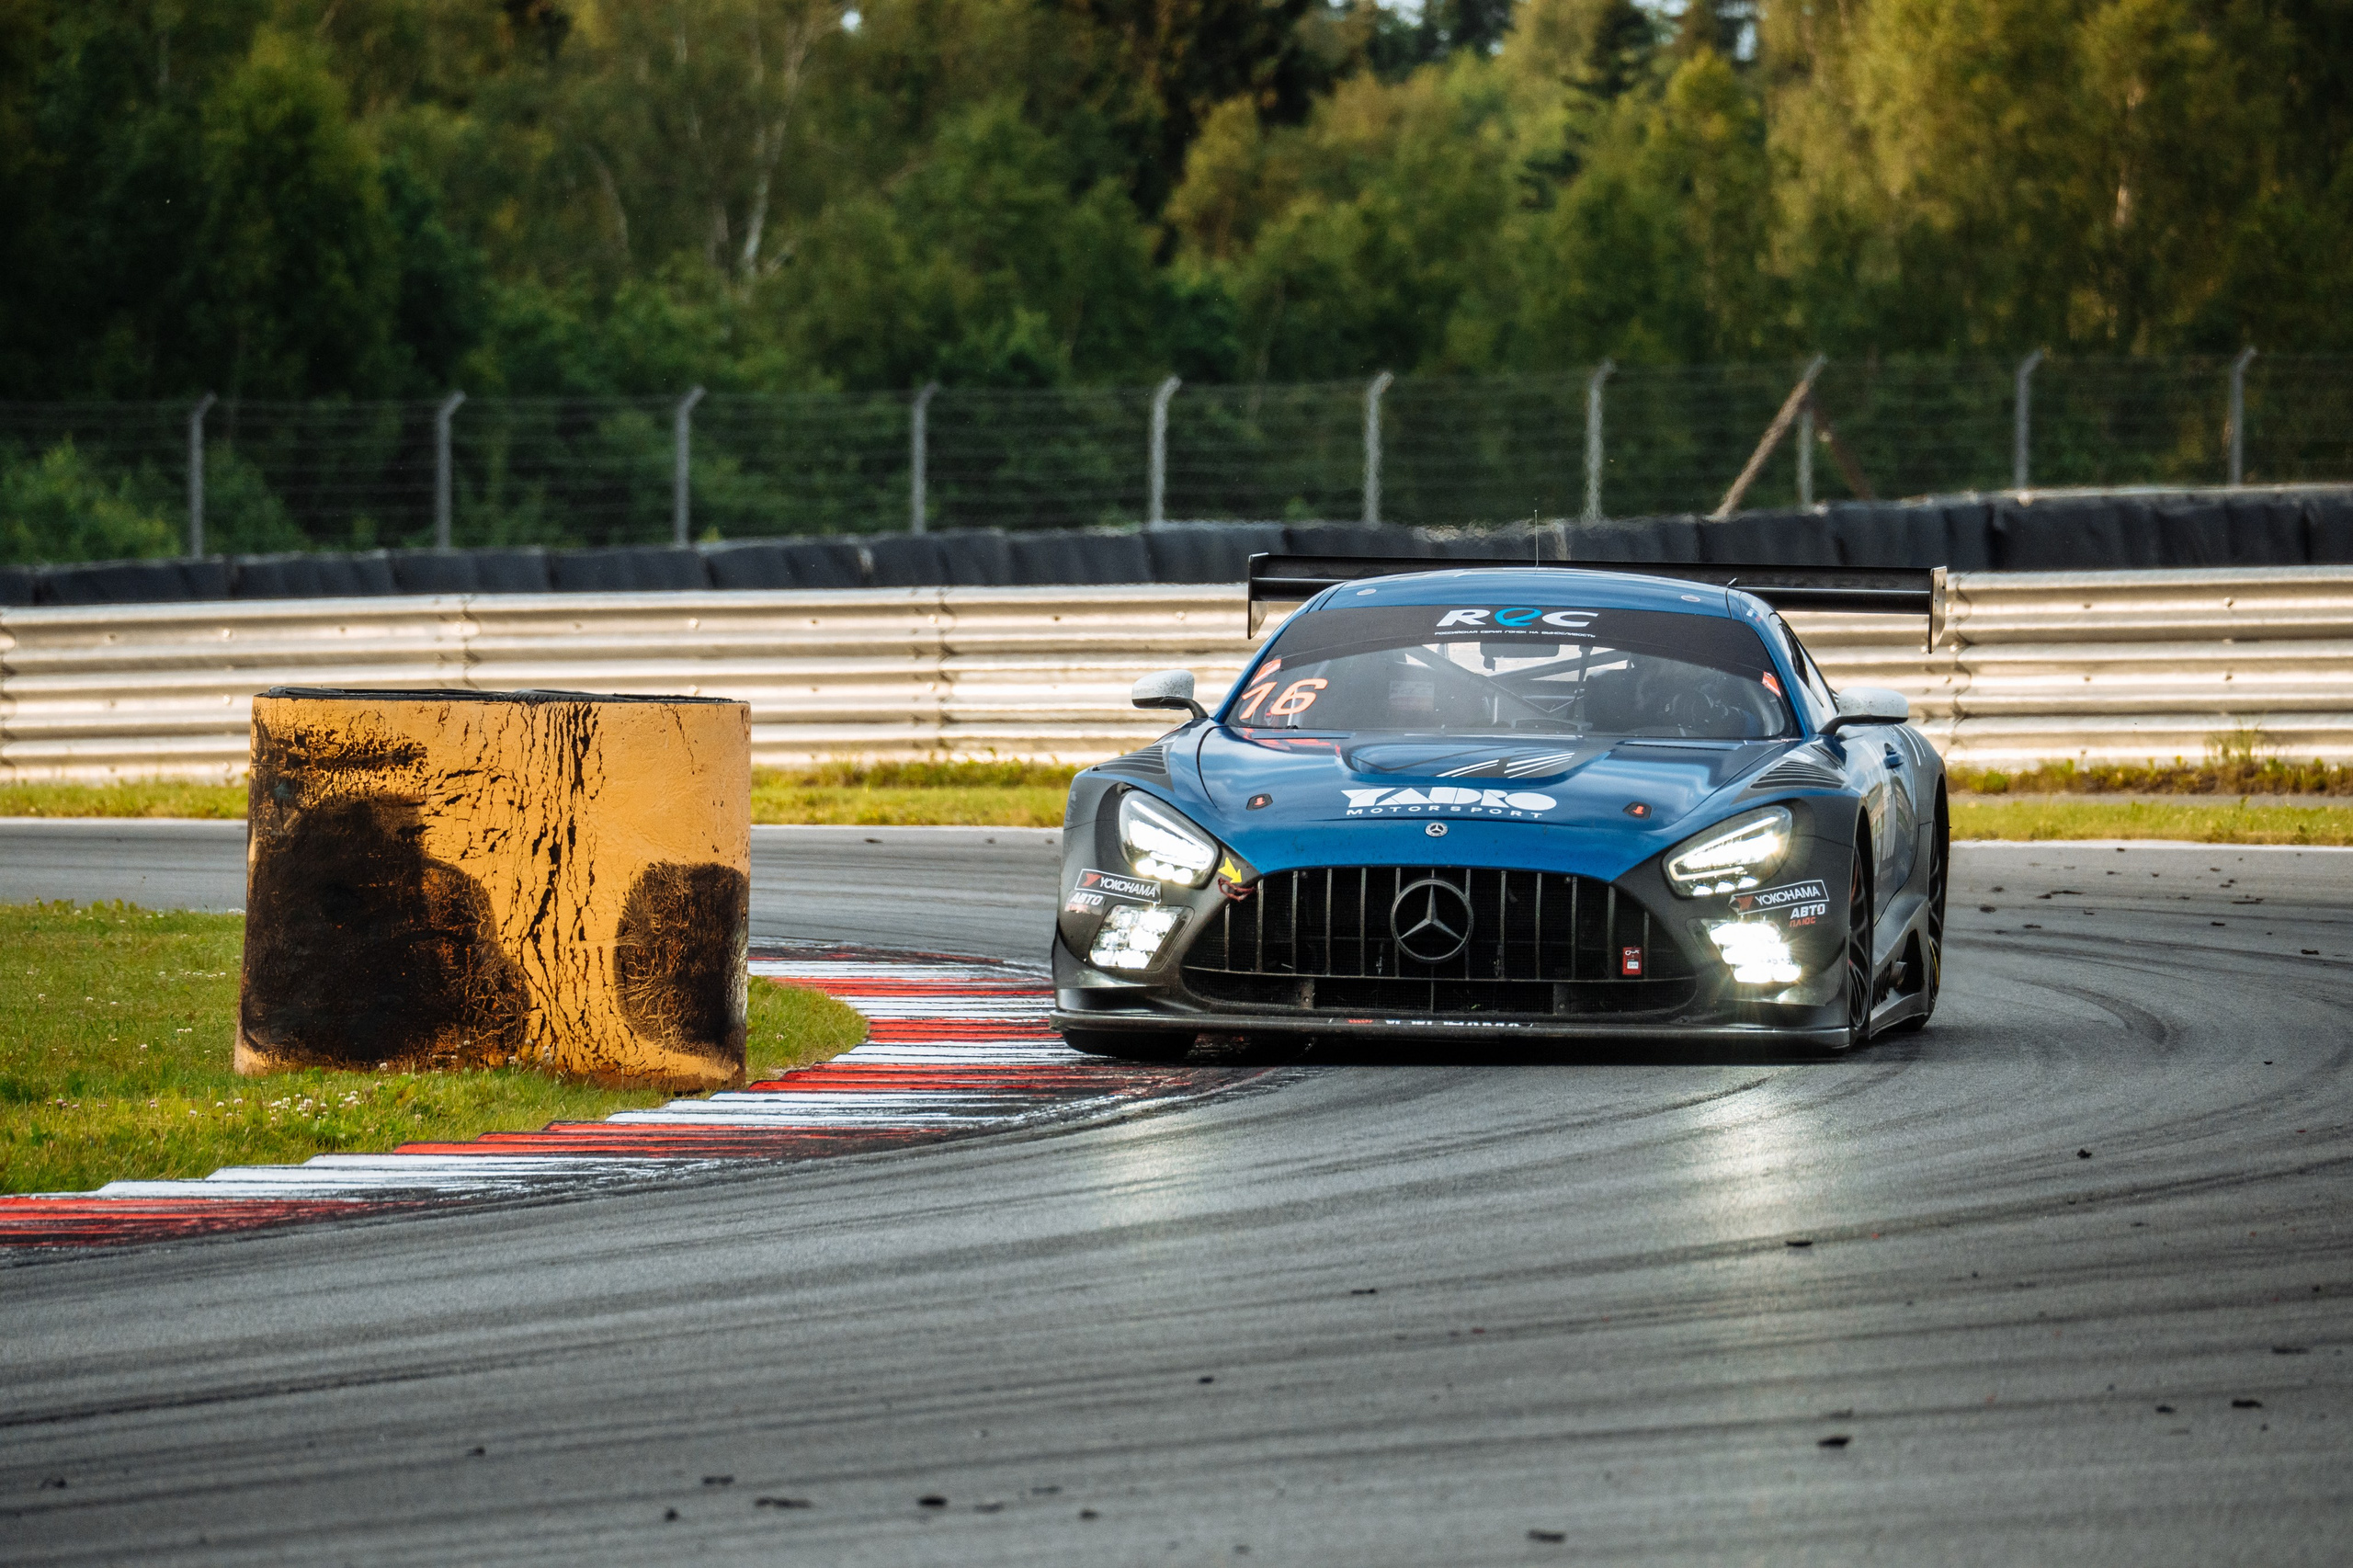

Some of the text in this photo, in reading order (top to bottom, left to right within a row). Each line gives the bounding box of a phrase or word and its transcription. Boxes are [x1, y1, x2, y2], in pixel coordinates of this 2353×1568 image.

[1239, 678, 1328, 720] 16
[1340, 787, 1557, 811] YADRO
[1347, 805, 1542, 819] MOTORSPORT
[1099, 876, 1156, 897] YOKOHAMA
[1755, 885, 1821, 905] YOKOHAMA
[1790, 903, 1826, 919] АВТО
[1789, 916, 1816, 927] ПЛЮС
